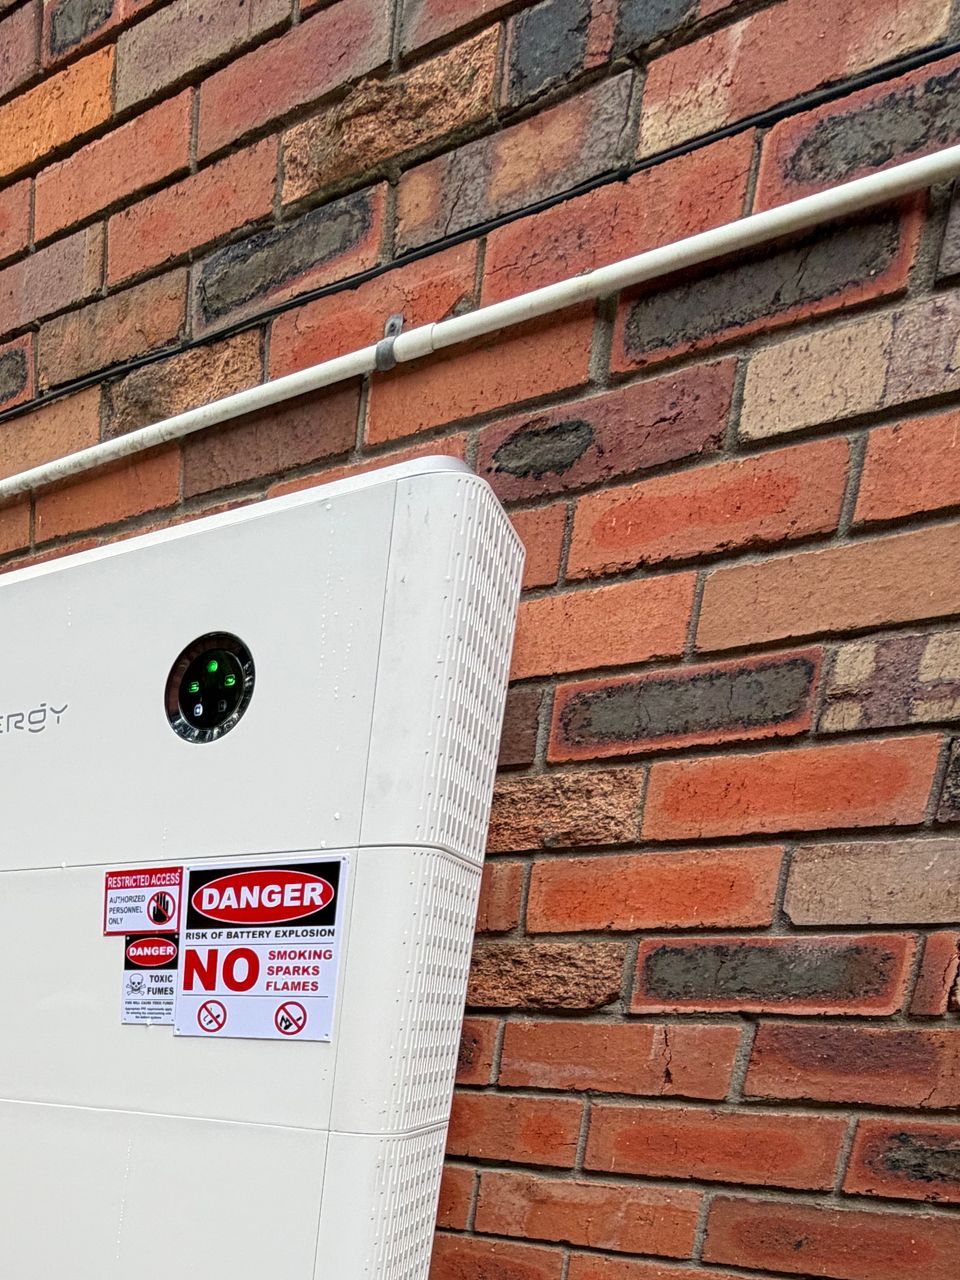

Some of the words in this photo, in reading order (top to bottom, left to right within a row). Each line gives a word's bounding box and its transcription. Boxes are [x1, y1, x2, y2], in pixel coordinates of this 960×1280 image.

[107, 875, 150, 888] RESTRICTED
[151, 873, 180, 885] ACCESS
[109, 894, 146, 904] AUTHORIZED
[201, 882, 324, 911] DANGER
[108, 906, 143, 915] PERSONNEL
[108, 917, 124, 925] ONLY
[185, 932, 208, 941] RISK
[211, 931, 224, 940] OF
[226, 930, 272, 940] BATTERY
[274, 928, 335, 939] EXPLOSION
[129, 946, 174, 957] DANGER
[268, 949, 333, 961] SMOKING
[182, 947, 260, 992] NO
[266, 965, 320, 976] SPARKS
[149, 975, 173, 983] TOXIC
[147, 987, 174, 995] FUMES
[265, 981, 319, 991] FLAMES
